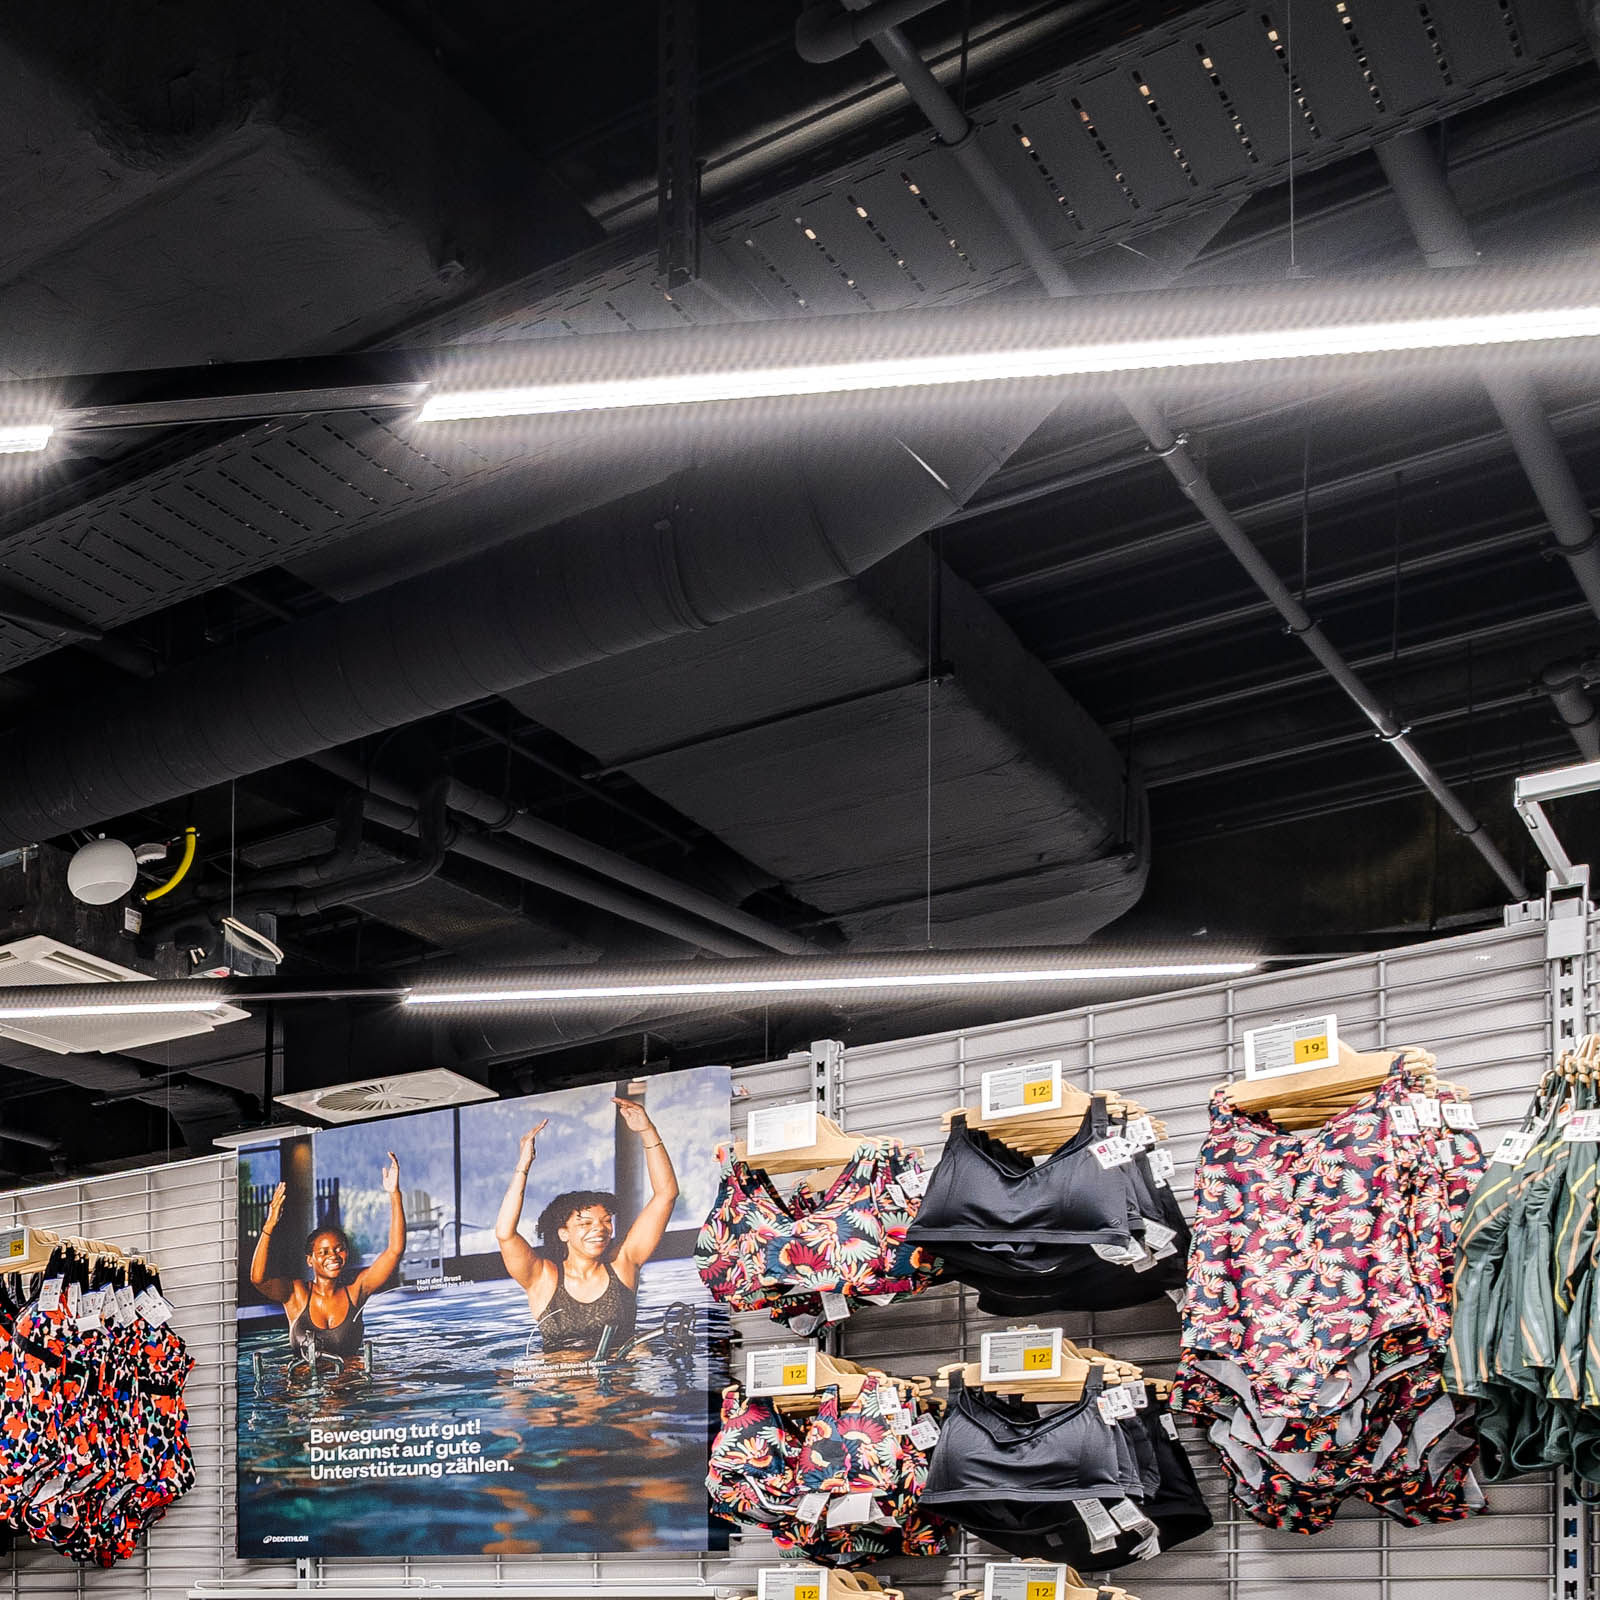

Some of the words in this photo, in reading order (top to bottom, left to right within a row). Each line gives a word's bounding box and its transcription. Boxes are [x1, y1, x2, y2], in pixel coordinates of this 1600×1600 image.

[1303, 1043, 1319, 1054] 19
[310, 1426, 406, 1444] Bewegung
[410, 1422, 439, 1438] tut
[442, 1418, 481, 1440] gut!
[310, 1447, 335, 1462] Du
[338, 1444, 399, 1461] kannst
[402, 1440, 434, 1457] auf
[435, 1440, 481, 1460] gute
[310, 1460, 443, 1480] Unterstützung
[445, 1456, 515, 1475] zählen.
[272, 1535, 309, 1543] DECATHLON
